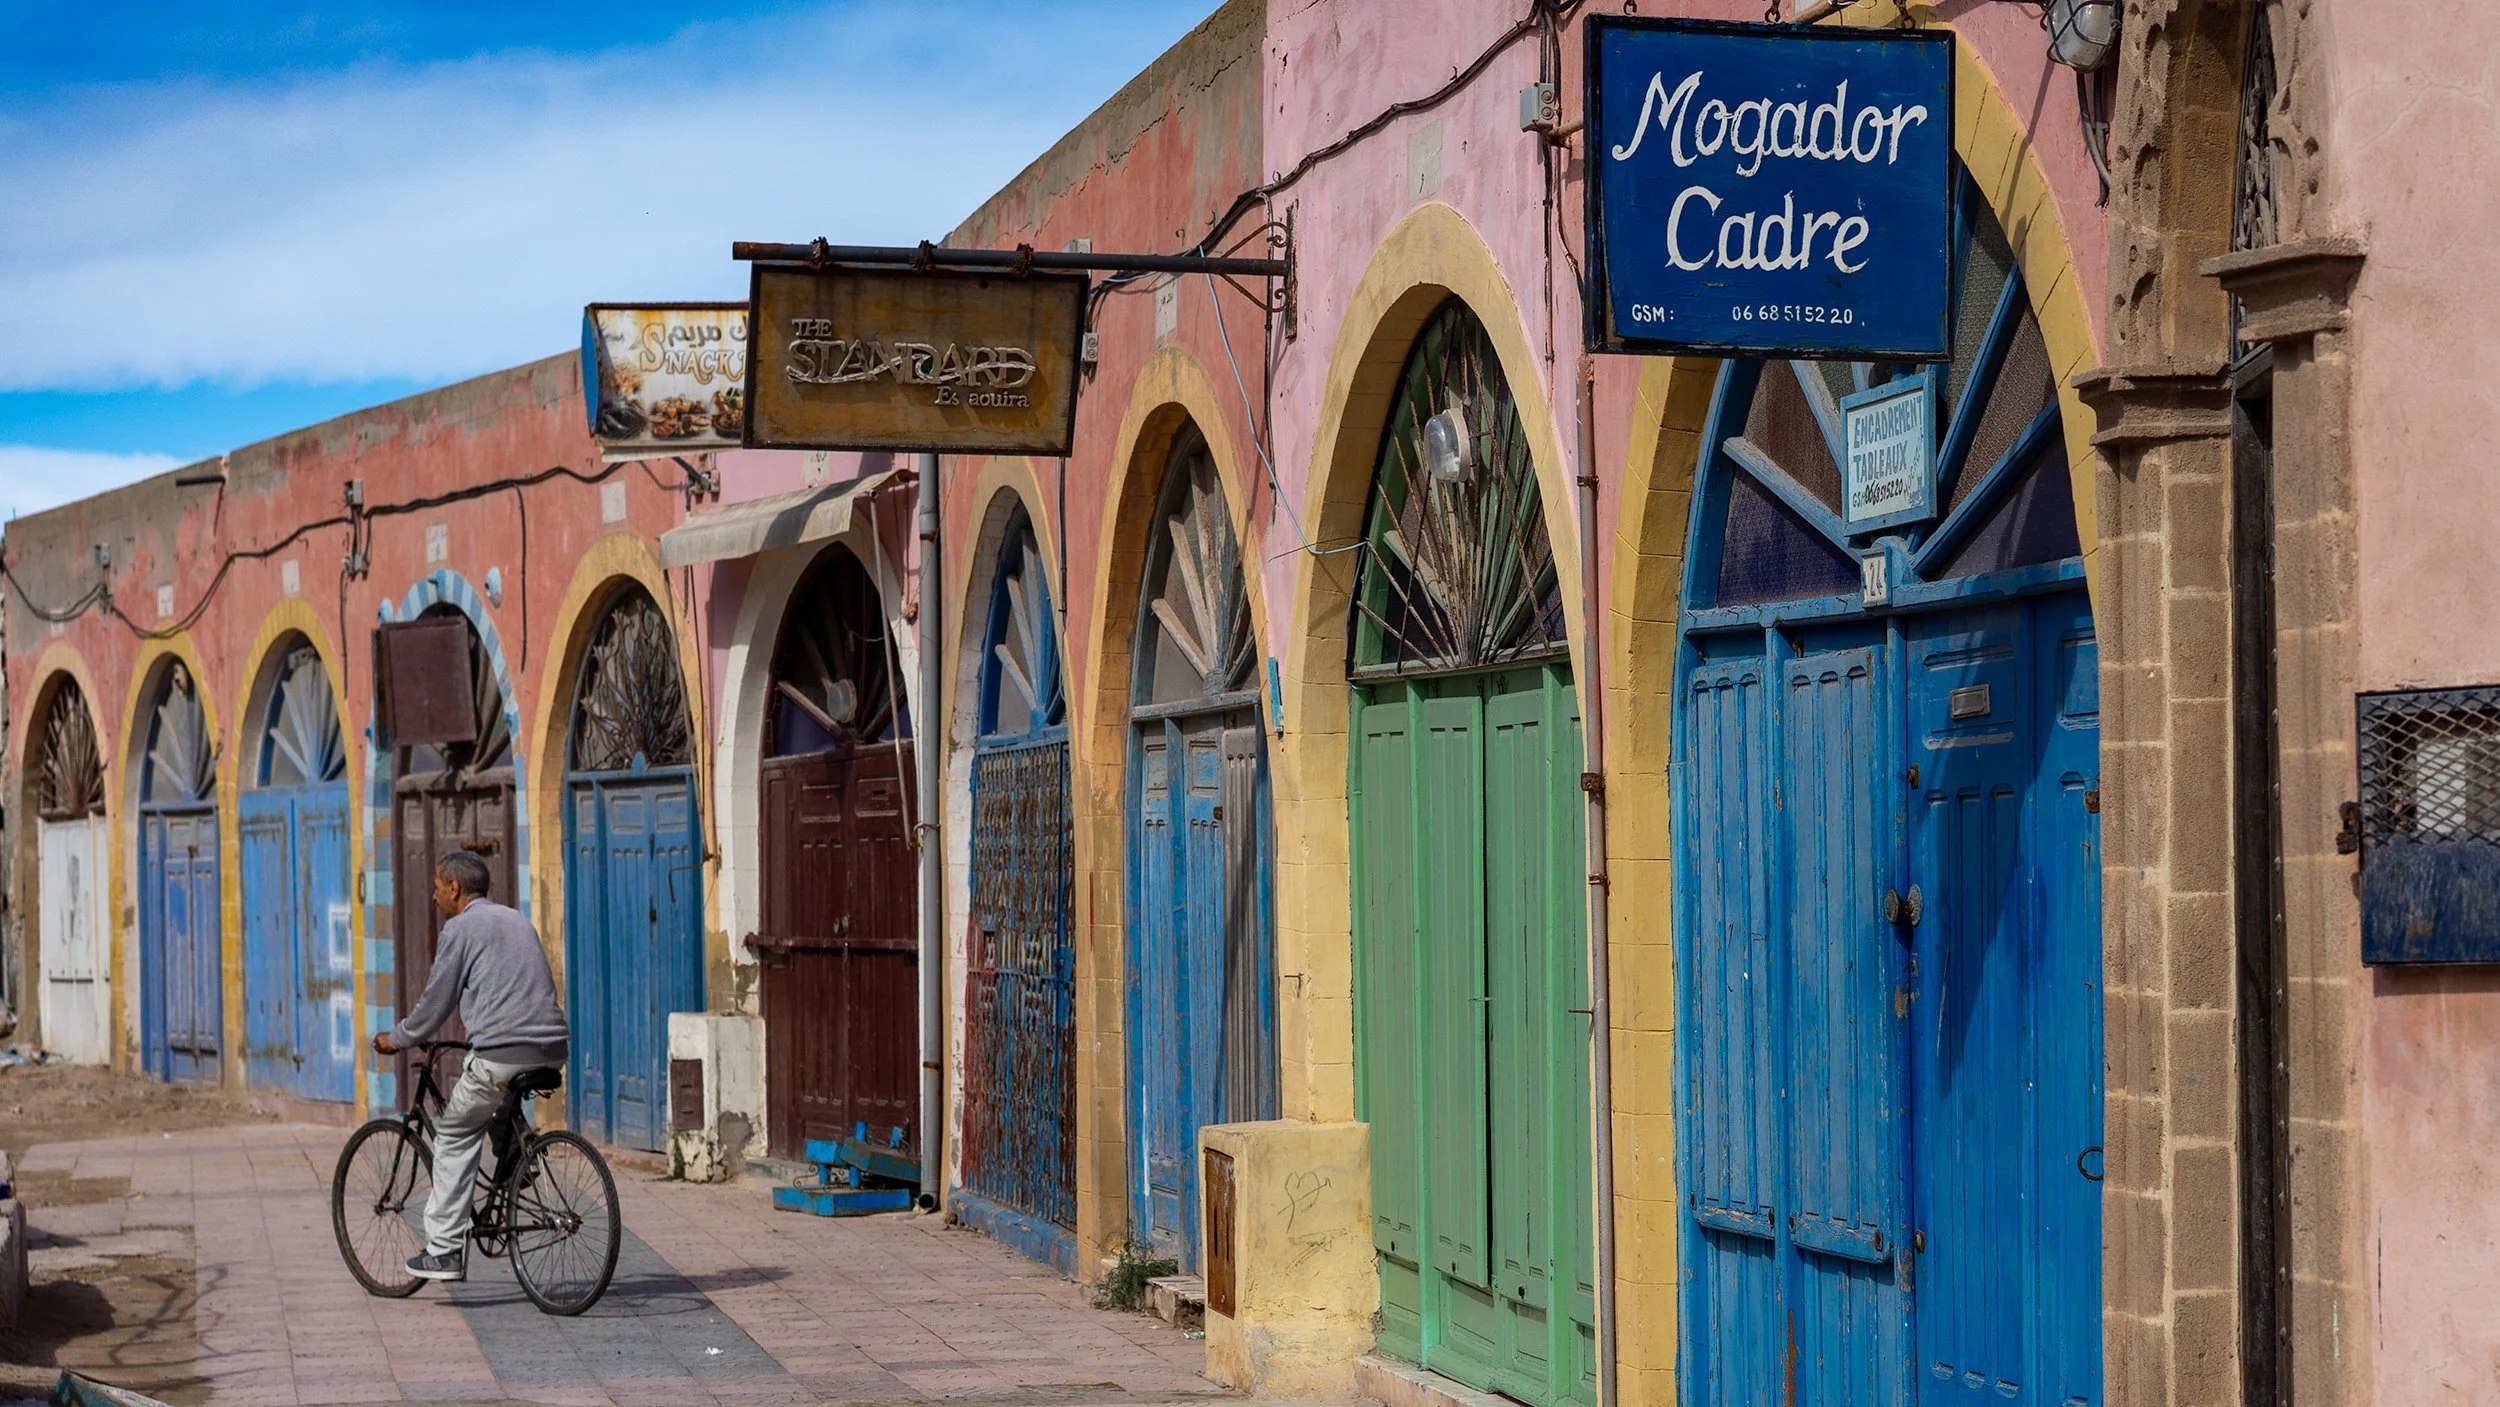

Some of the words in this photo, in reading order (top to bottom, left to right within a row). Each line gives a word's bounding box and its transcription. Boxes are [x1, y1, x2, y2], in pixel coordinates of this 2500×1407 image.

[1612, 71, 1927, 177] Mogador
[1665, 185, 1870, 274] Cadre
[668, 323, 722, 348] مريم
[792, 318, 832, 337] THE
[640, 323, 740, 385] SNACK
[786, 339, 1036, 388] STANDARD
[1853, 396, 1923, 449] ENCADREMENT
[1853, 440, 1908, 484] TABLEAUX
[1869, 559, 1883, 597] 24
